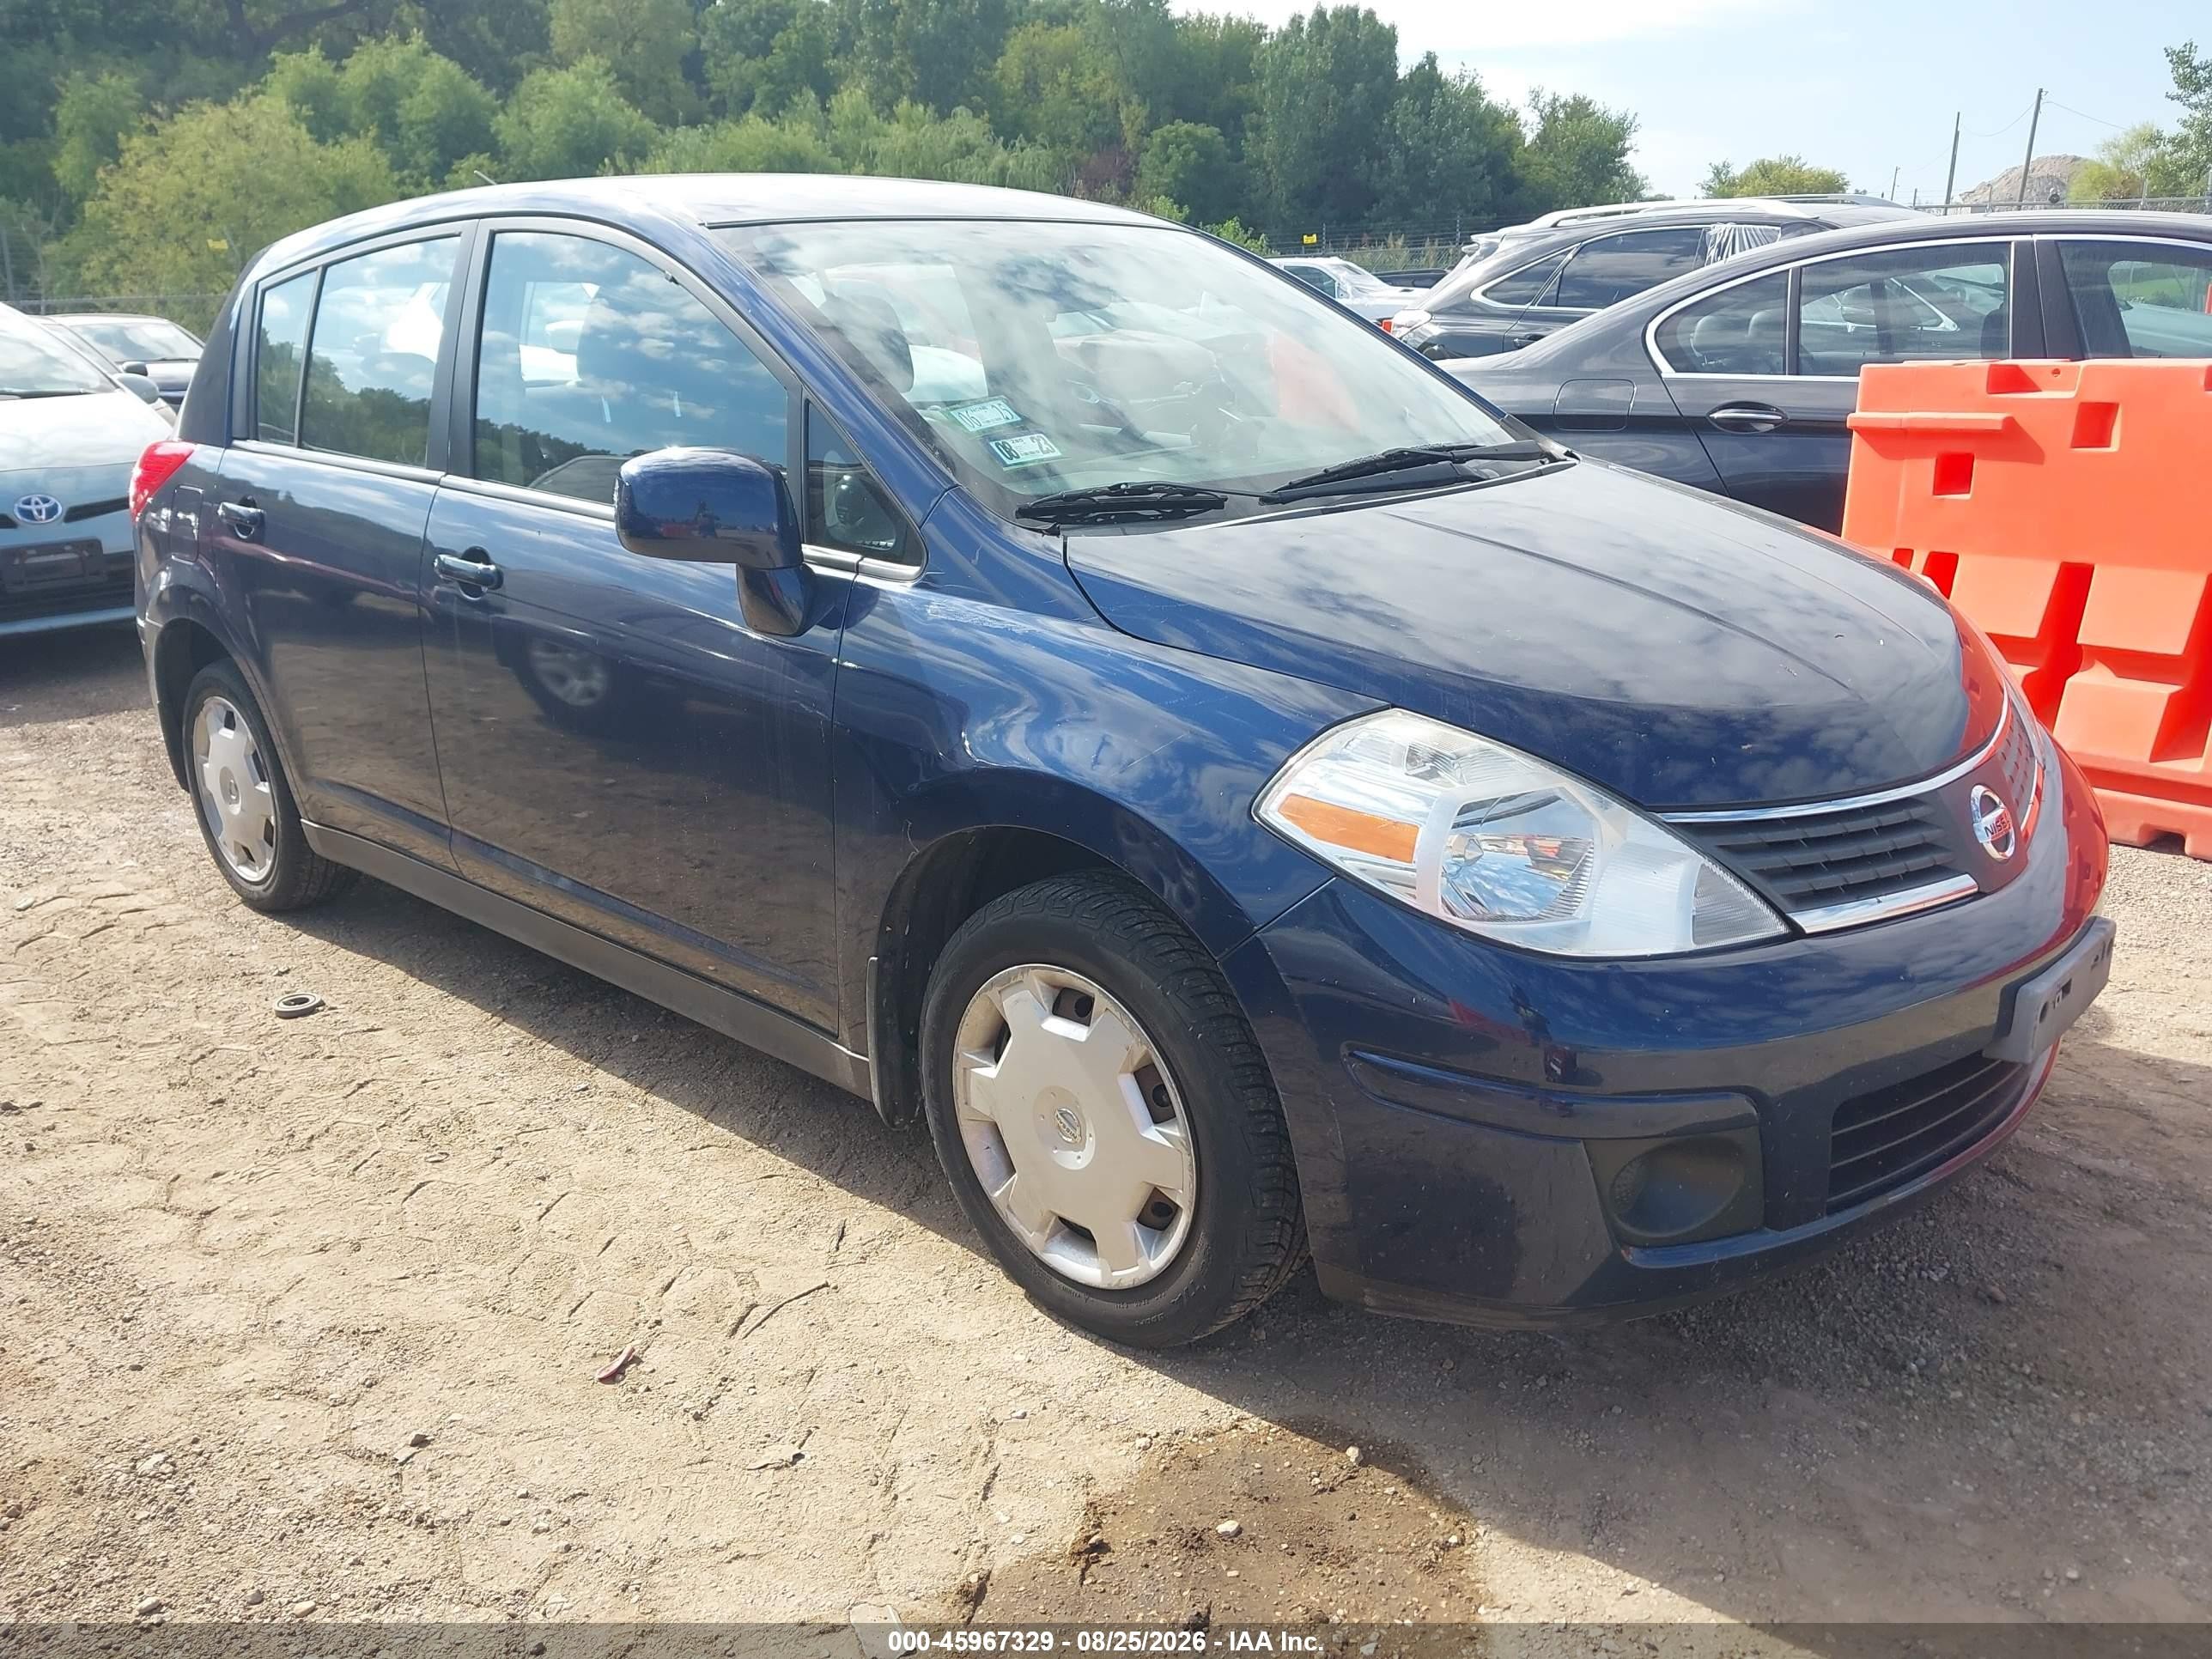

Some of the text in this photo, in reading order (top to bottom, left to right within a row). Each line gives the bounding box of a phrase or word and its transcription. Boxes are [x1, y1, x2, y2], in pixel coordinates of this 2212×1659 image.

[957, 410, 982, 428] 06
[994, 441, 1021, 460] 08
[1030, 435, 1055, 455] 23
[1984, 812, 2011, 838] NISSA
[1055, 1114, 1079, 1141] NISSAN
